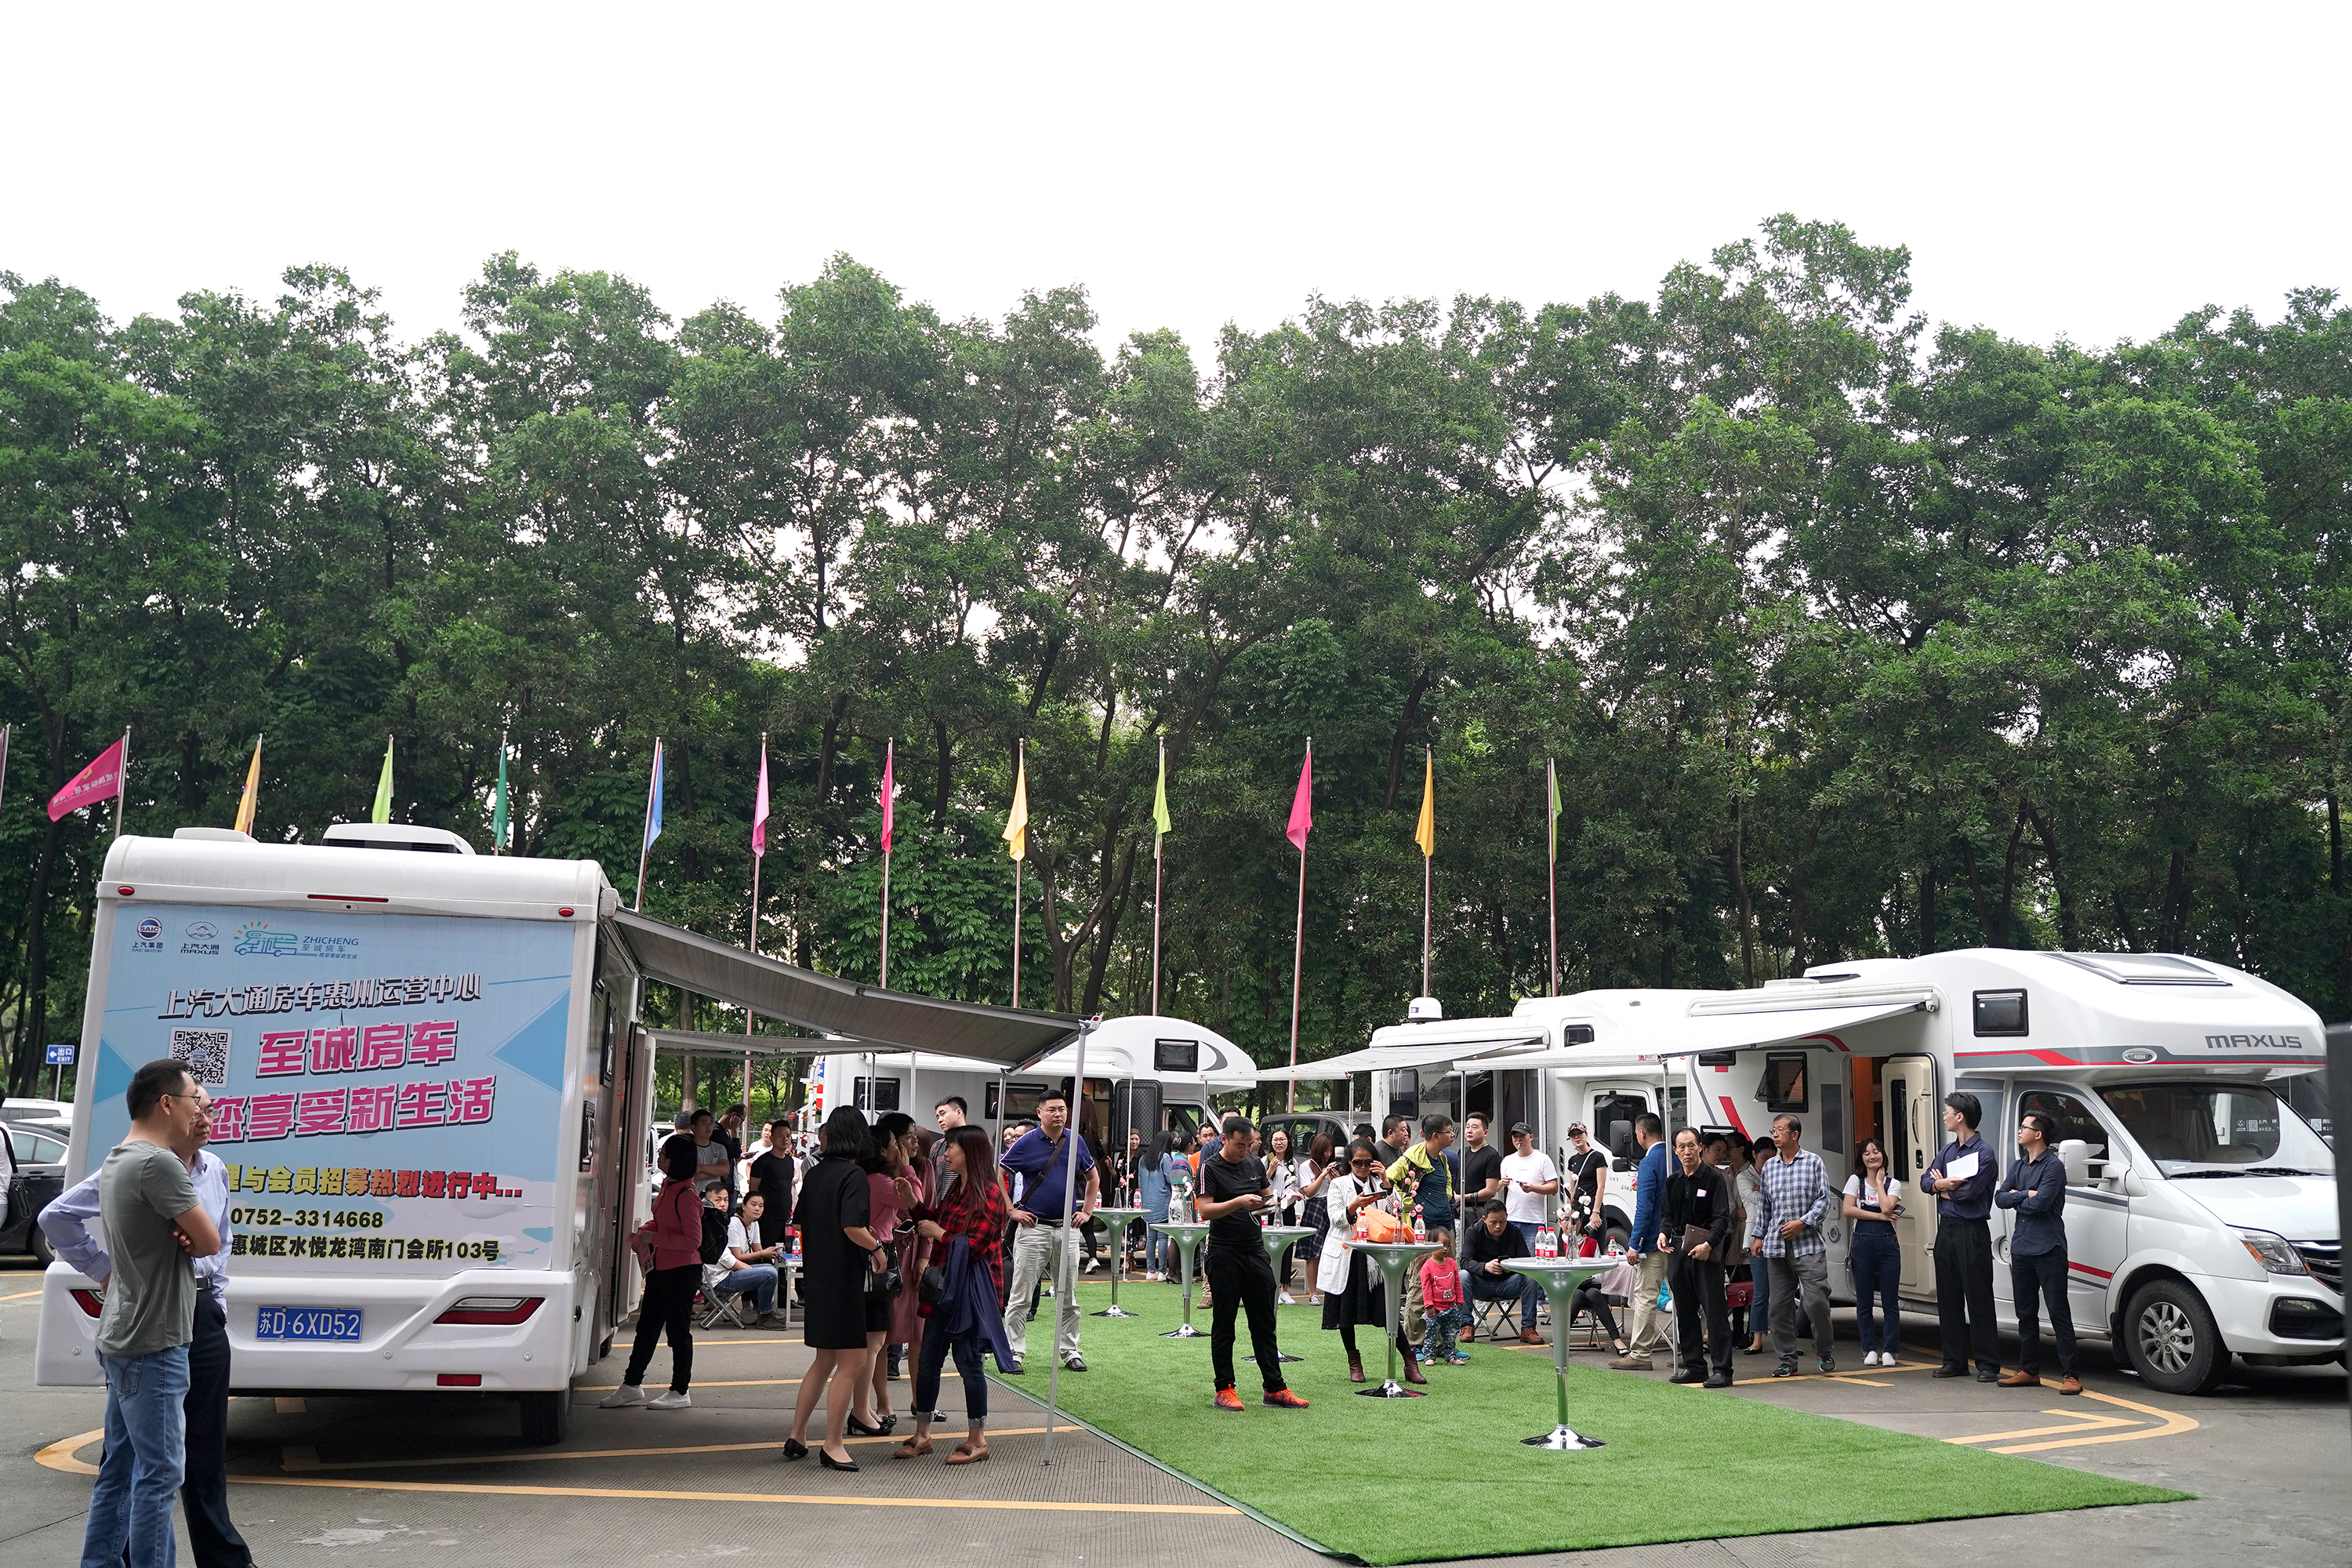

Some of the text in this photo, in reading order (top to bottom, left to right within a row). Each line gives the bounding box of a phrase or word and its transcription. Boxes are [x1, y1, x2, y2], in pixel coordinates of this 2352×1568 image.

[301, 944, 346, 953] 至诚房车
[303, 935, 359, 946] ZHICHENG
[158, 972, 481, 1018] 上汽大通房车惠州运营中心
[256, 1019, 459, 1078] 至诚房车
[2205, 1035, 2303, 1049] MAXUS
[57, 1047, 72, 1056] 出口
[230, 1207, 383, 1229] 0752-3314668
[231, 1234, 500, 1261] 惠城区水悦龙湾南门会所103号
